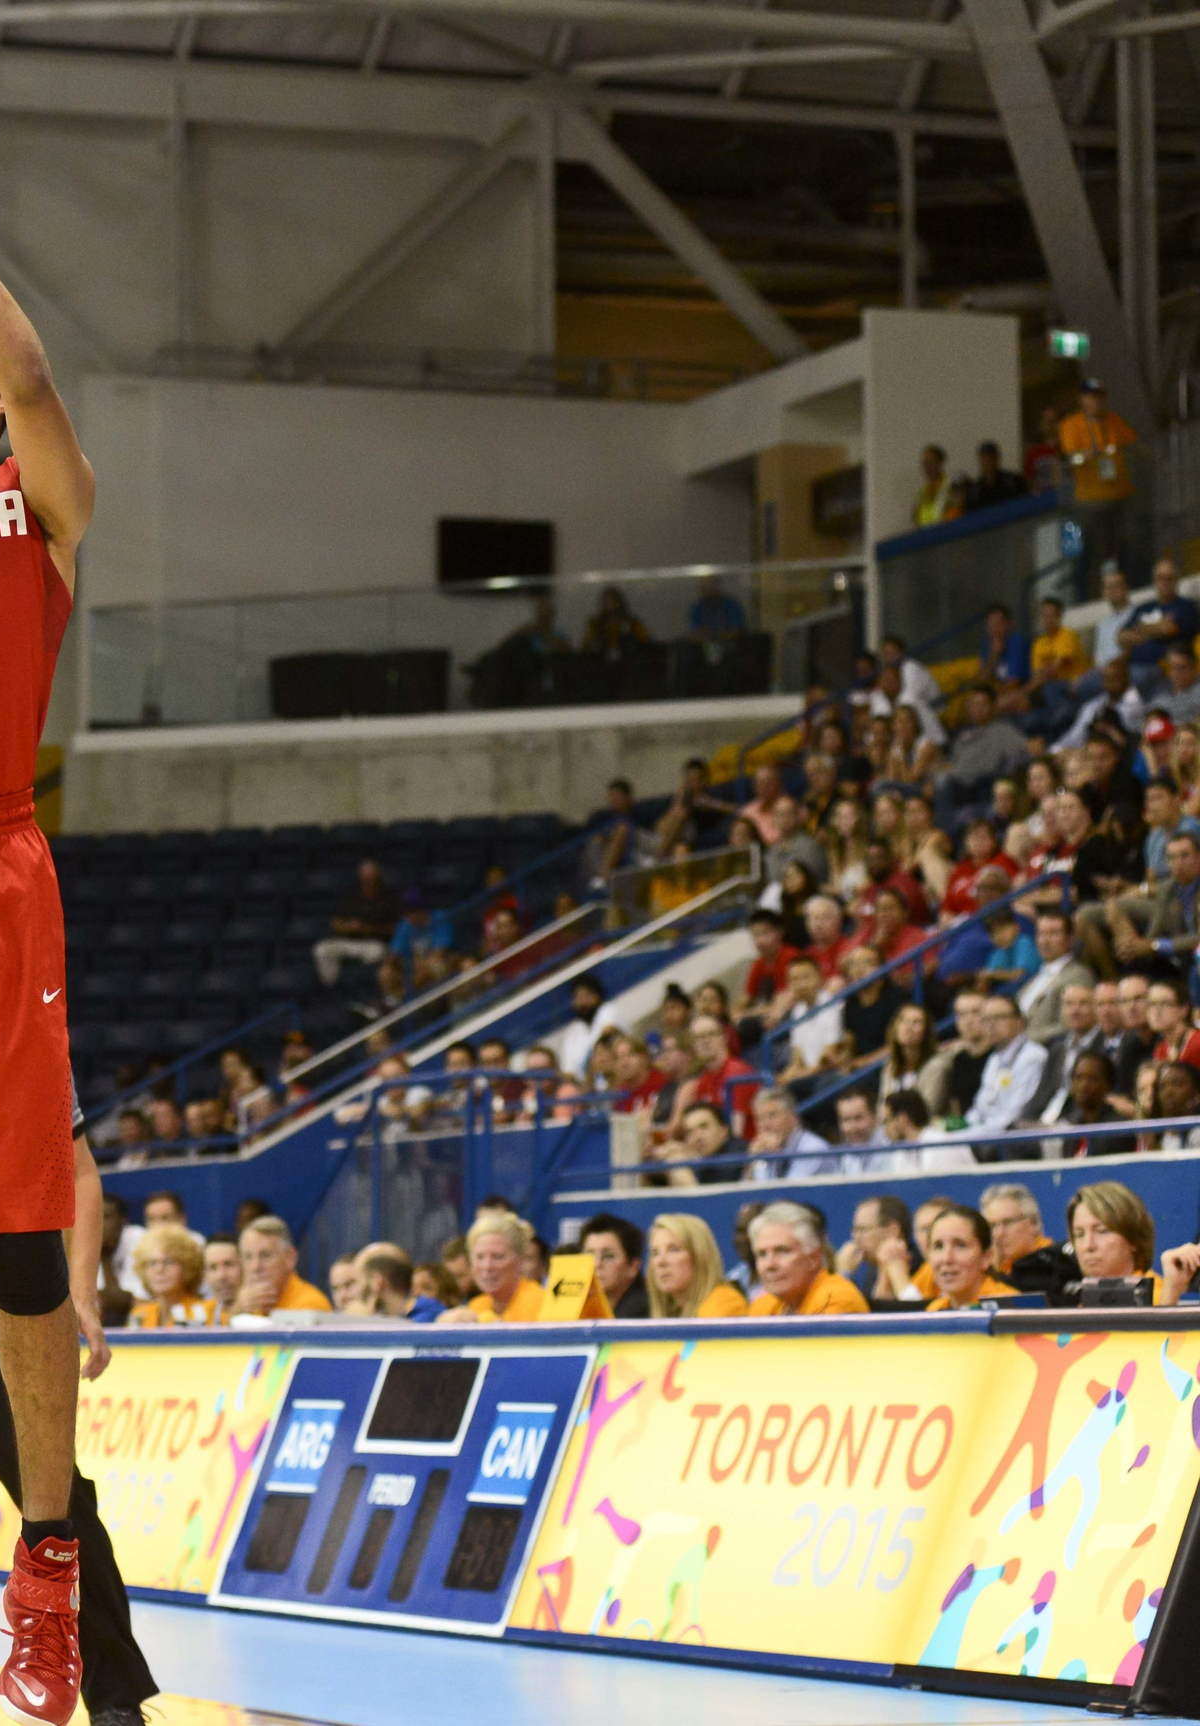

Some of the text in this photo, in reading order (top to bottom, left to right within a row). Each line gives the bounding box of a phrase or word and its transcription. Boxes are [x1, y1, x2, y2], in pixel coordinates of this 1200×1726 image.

[273, 1420, 335, 1471] ARG
[480, 1425, 550, 1481] CAN
[680, 1403, 955, 1491] TORONTO
[96, 1469, 176, 1535] 2015
[771, 1502, 927, 1593] 2015
